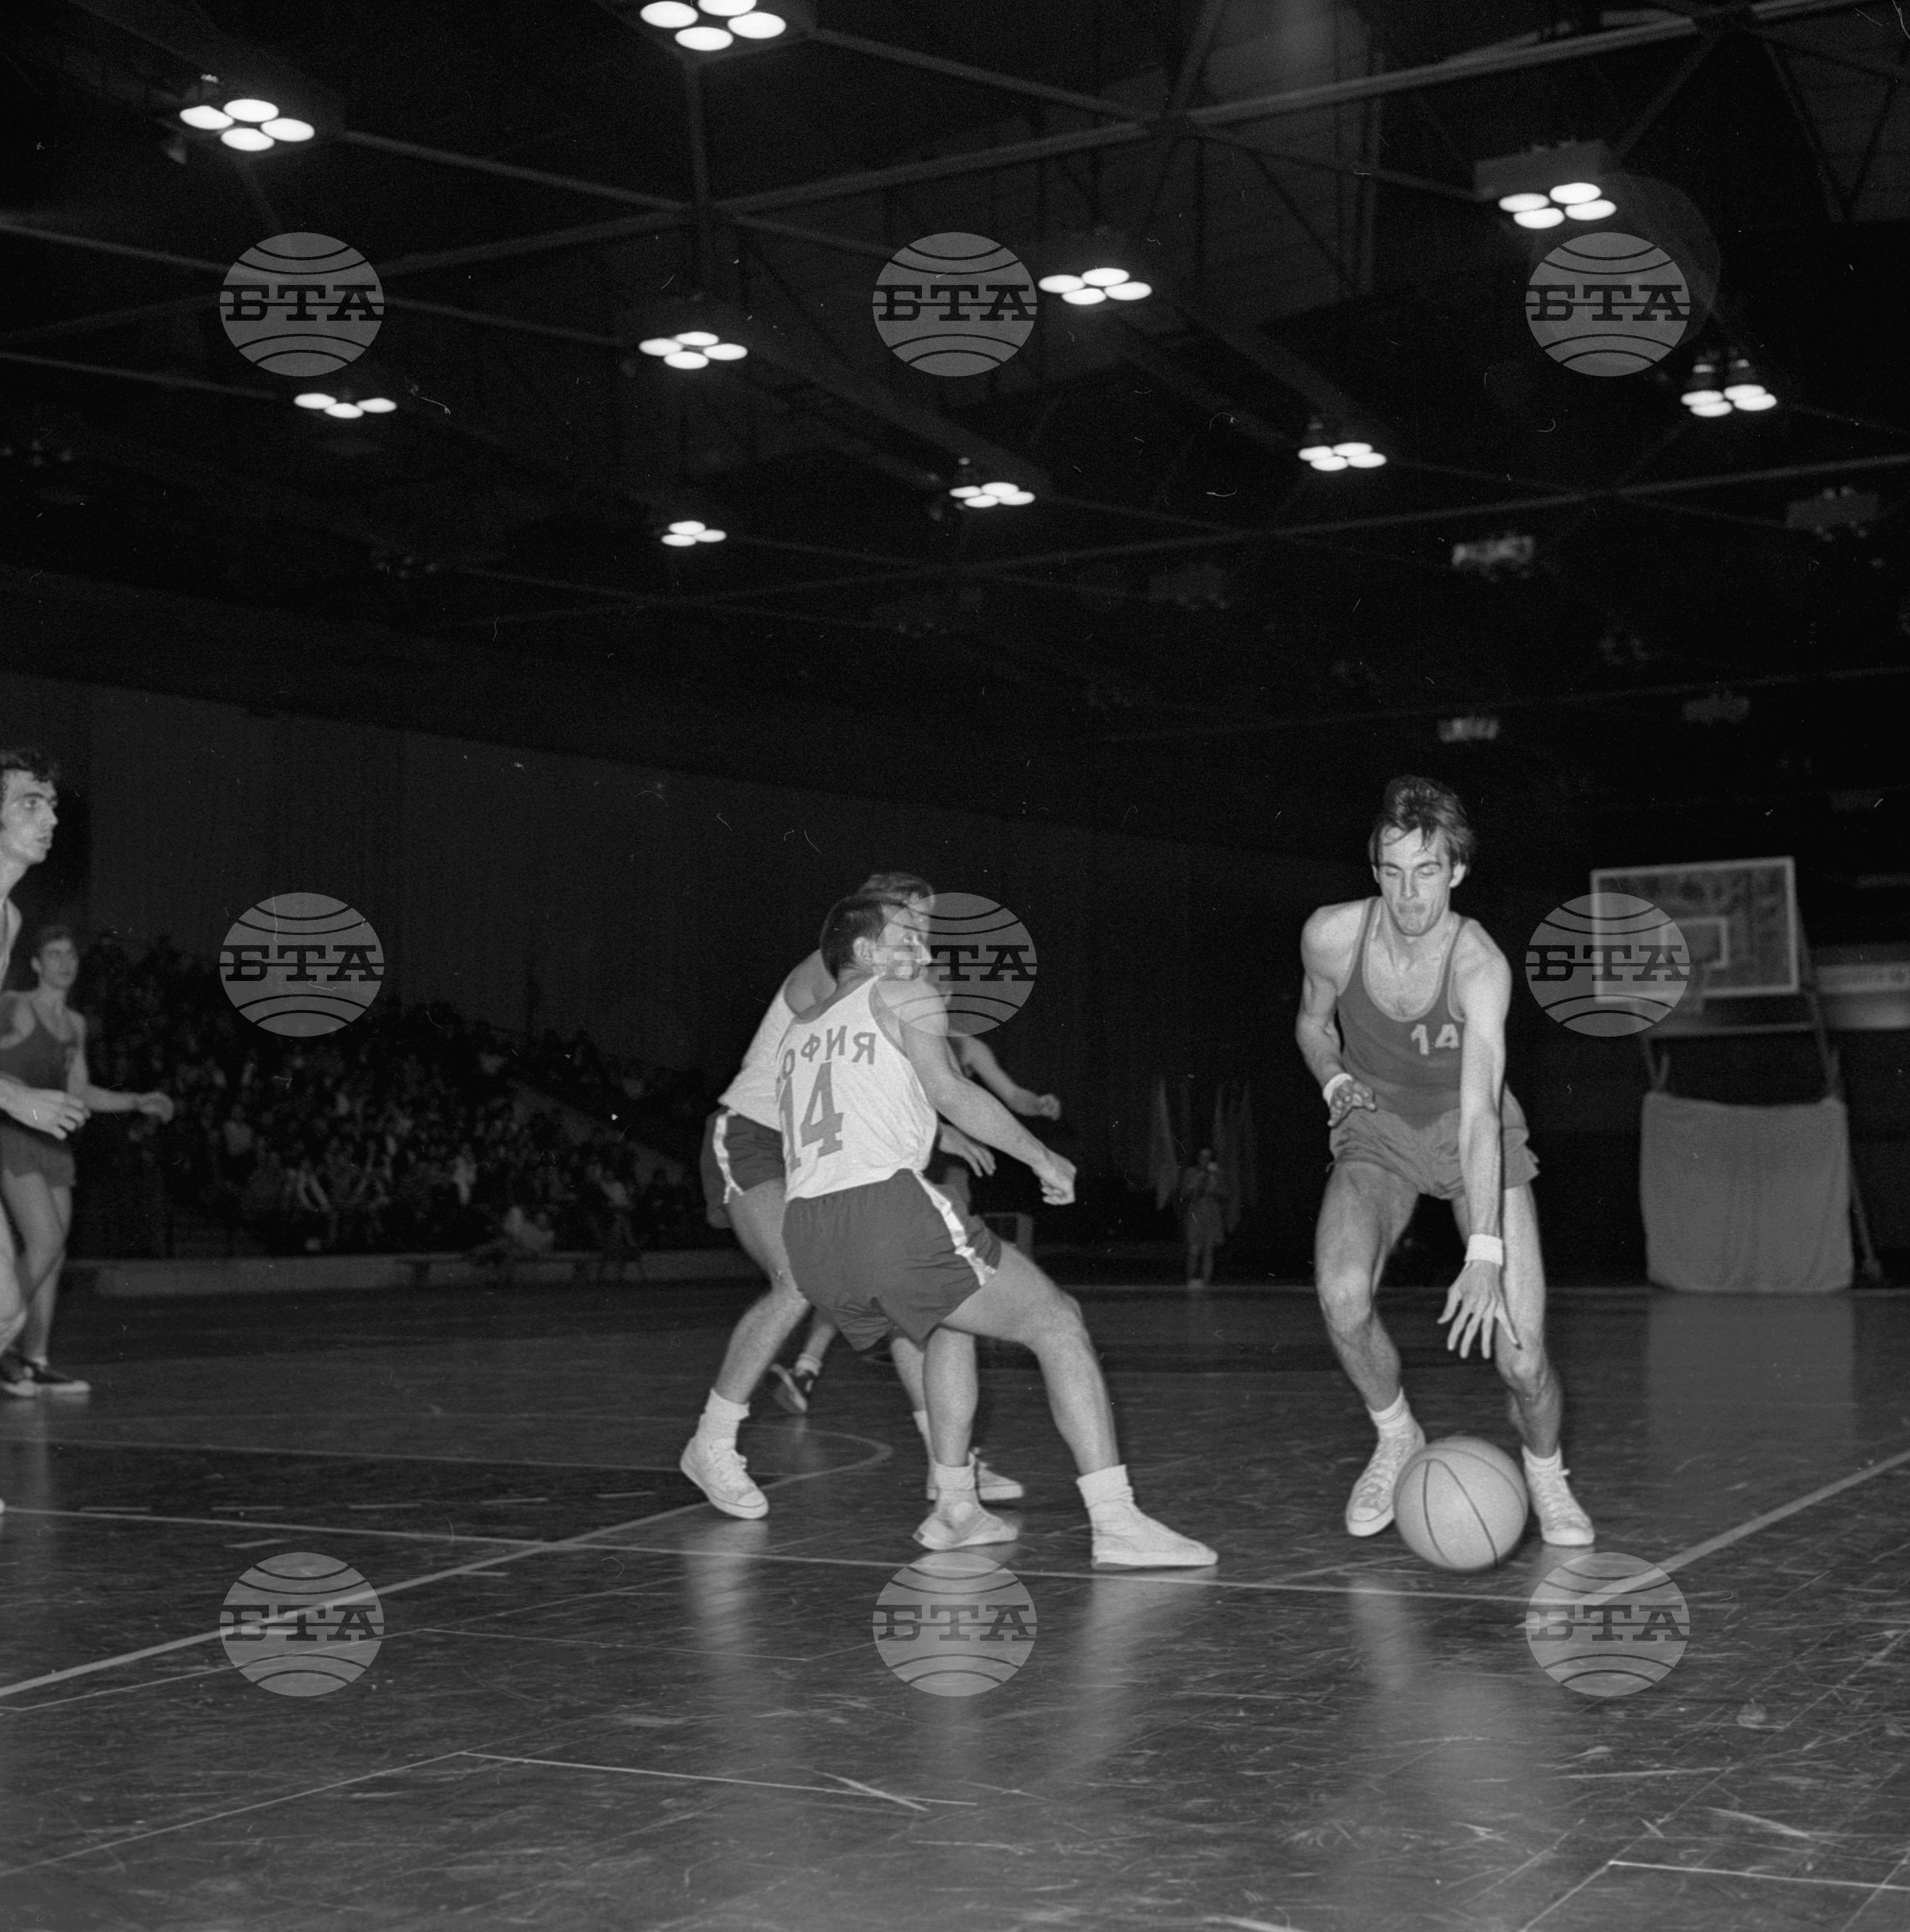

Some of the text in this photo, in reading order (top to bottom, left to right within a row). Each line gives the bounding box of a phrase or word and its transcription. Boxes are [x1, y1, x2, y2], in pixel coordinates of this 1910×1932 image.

[776, 1025, 877, 1106] ОФИЯ
[1411, 1023, 1459, 1055] 14
[779, 1062, 843, 1174] 14
